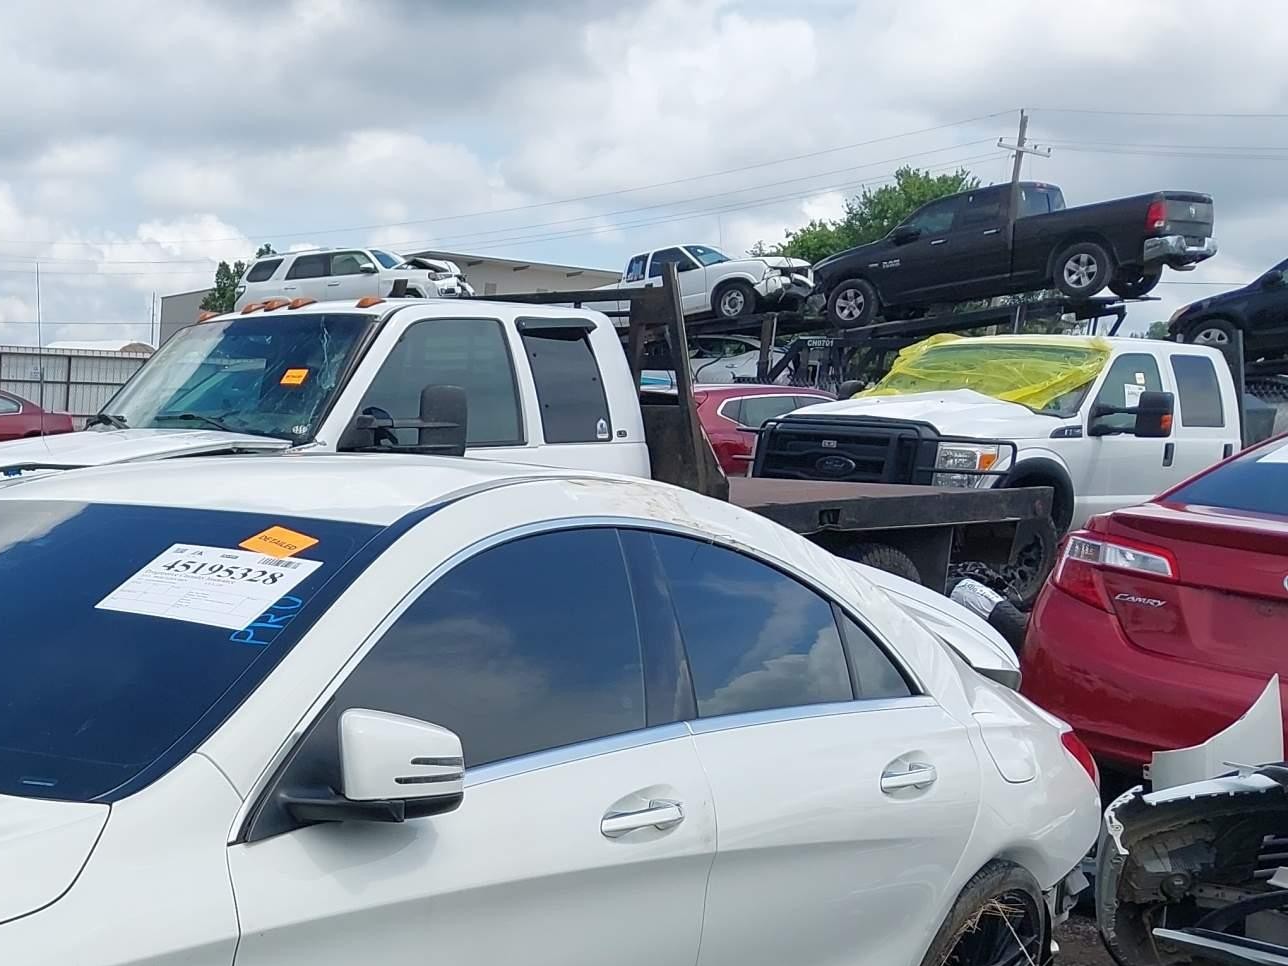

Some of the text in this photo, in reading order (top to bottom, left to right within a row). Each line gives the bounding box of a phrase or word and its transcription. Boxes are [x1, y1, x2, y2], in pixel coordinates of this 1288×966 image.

[258, 534, 297, 551] DETAILED
[162, 559, 285, 585] 45195328
[1114, 593, 1167, 607] CAMRY
